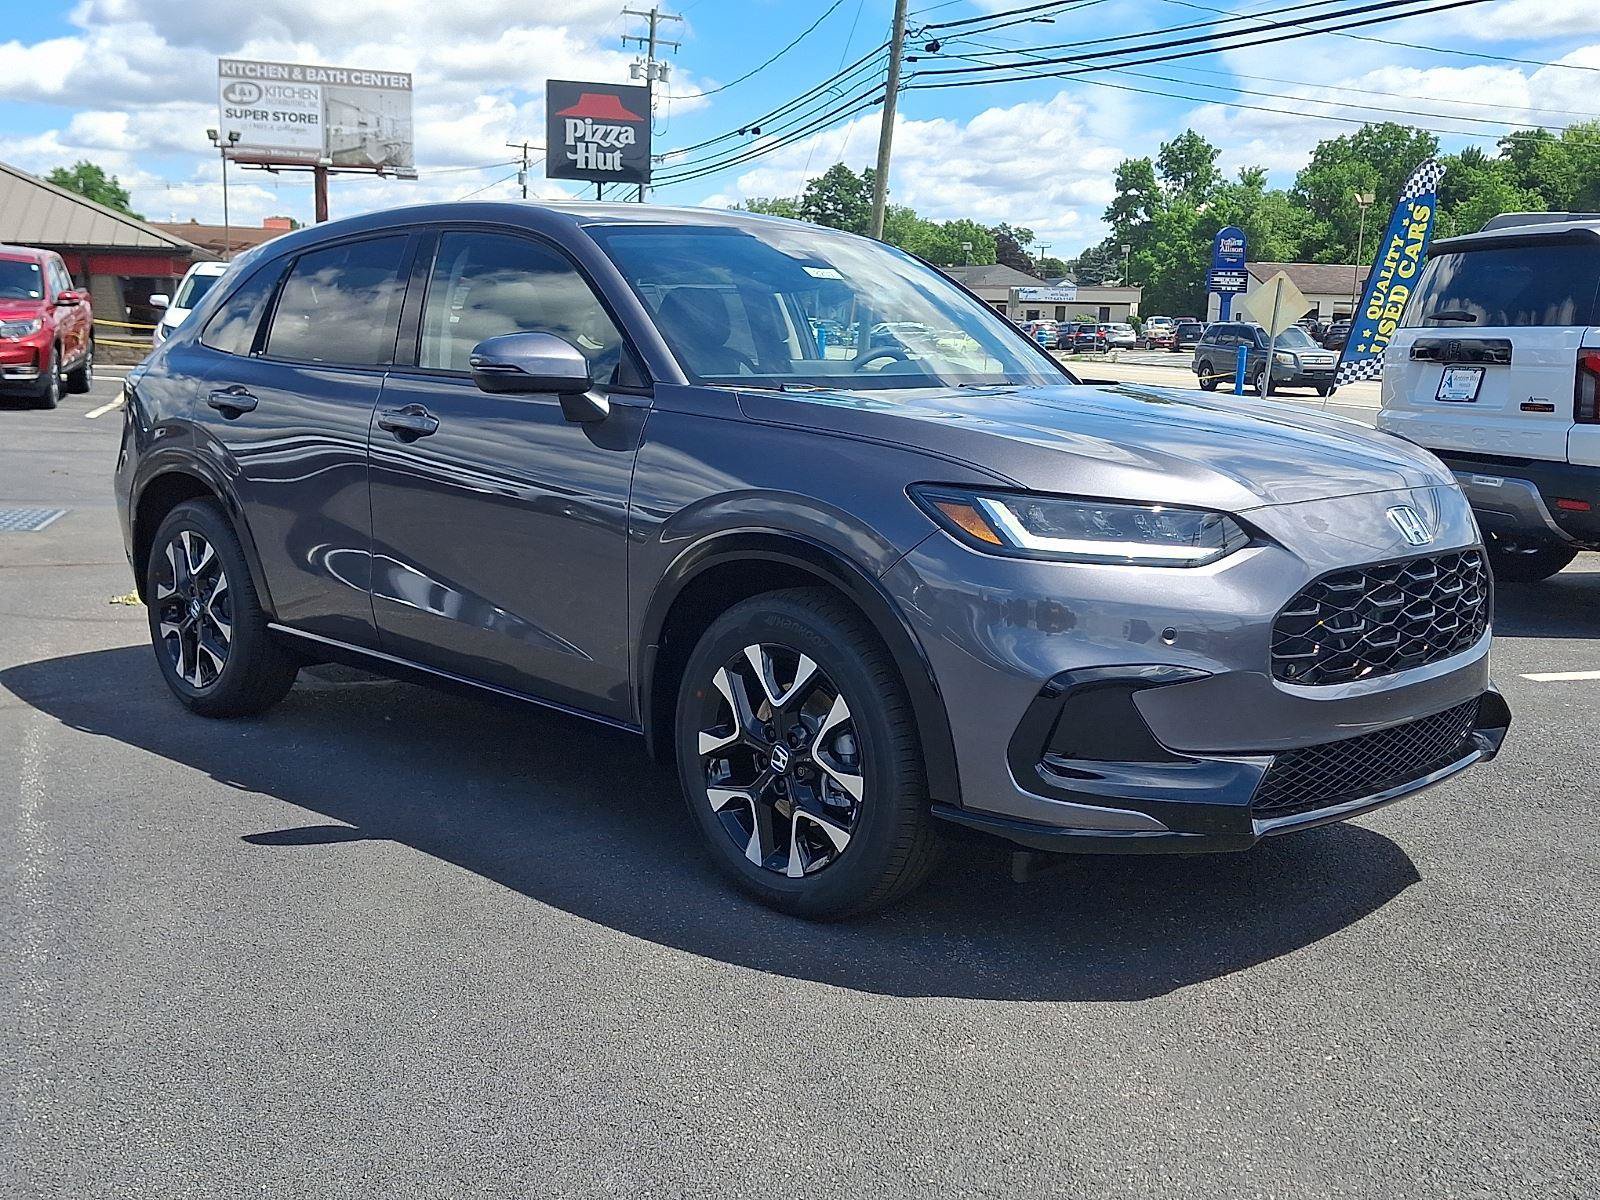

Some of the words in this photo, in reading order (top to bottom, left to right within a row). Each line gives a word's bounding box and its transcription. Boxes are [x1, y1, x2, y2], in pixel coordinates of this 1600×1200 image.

[221, 62, 289, 79] KITCHEN
[292, 67, 304, 79] &
[306, 69, 347, 84] BATH
[350, 72, 410, 88] CENTER
[264, 86, 318, 101] KITCHEN
[225, 108, 268, 121] SUPER
[272, 111, 318, 124] STORE!
[565, 117, 636, 148] Pizza
[566, 142, 624, 171] Hut
[1366, 233, 1405, 320] QUALITY
[1369, 284, 1409, 354] USED
[1398, 204, 1431, 279] CARS
